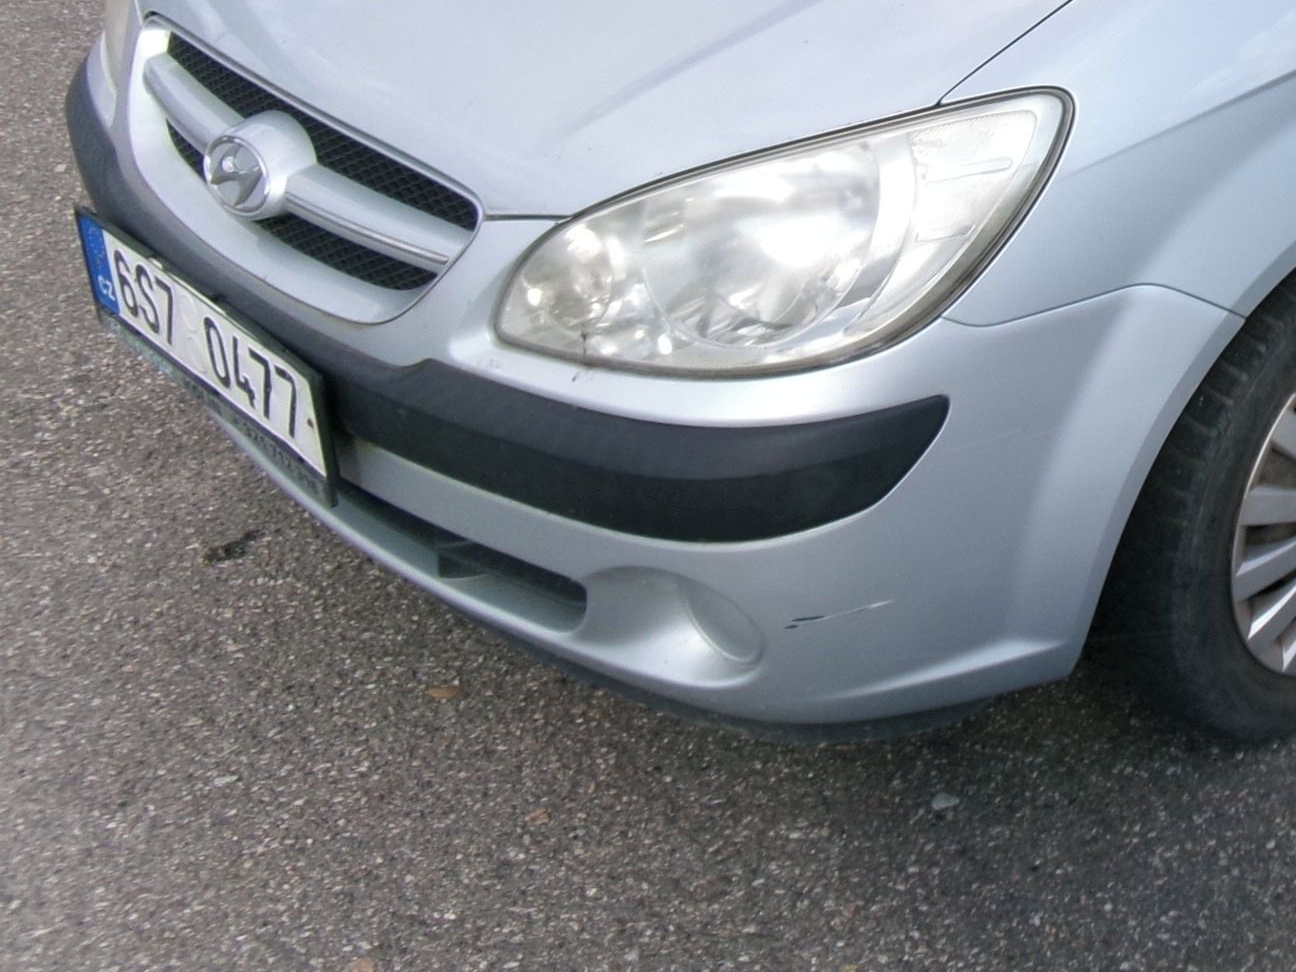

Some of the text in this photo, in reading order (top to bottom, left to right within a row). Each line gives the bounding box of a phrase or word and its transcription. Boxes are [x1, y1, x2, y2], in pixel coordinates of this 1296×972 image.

[97, 275, 116, 303] CZ
[113, 249, 174, 346] 6S7
[204, 316, 298, 439] 0477
